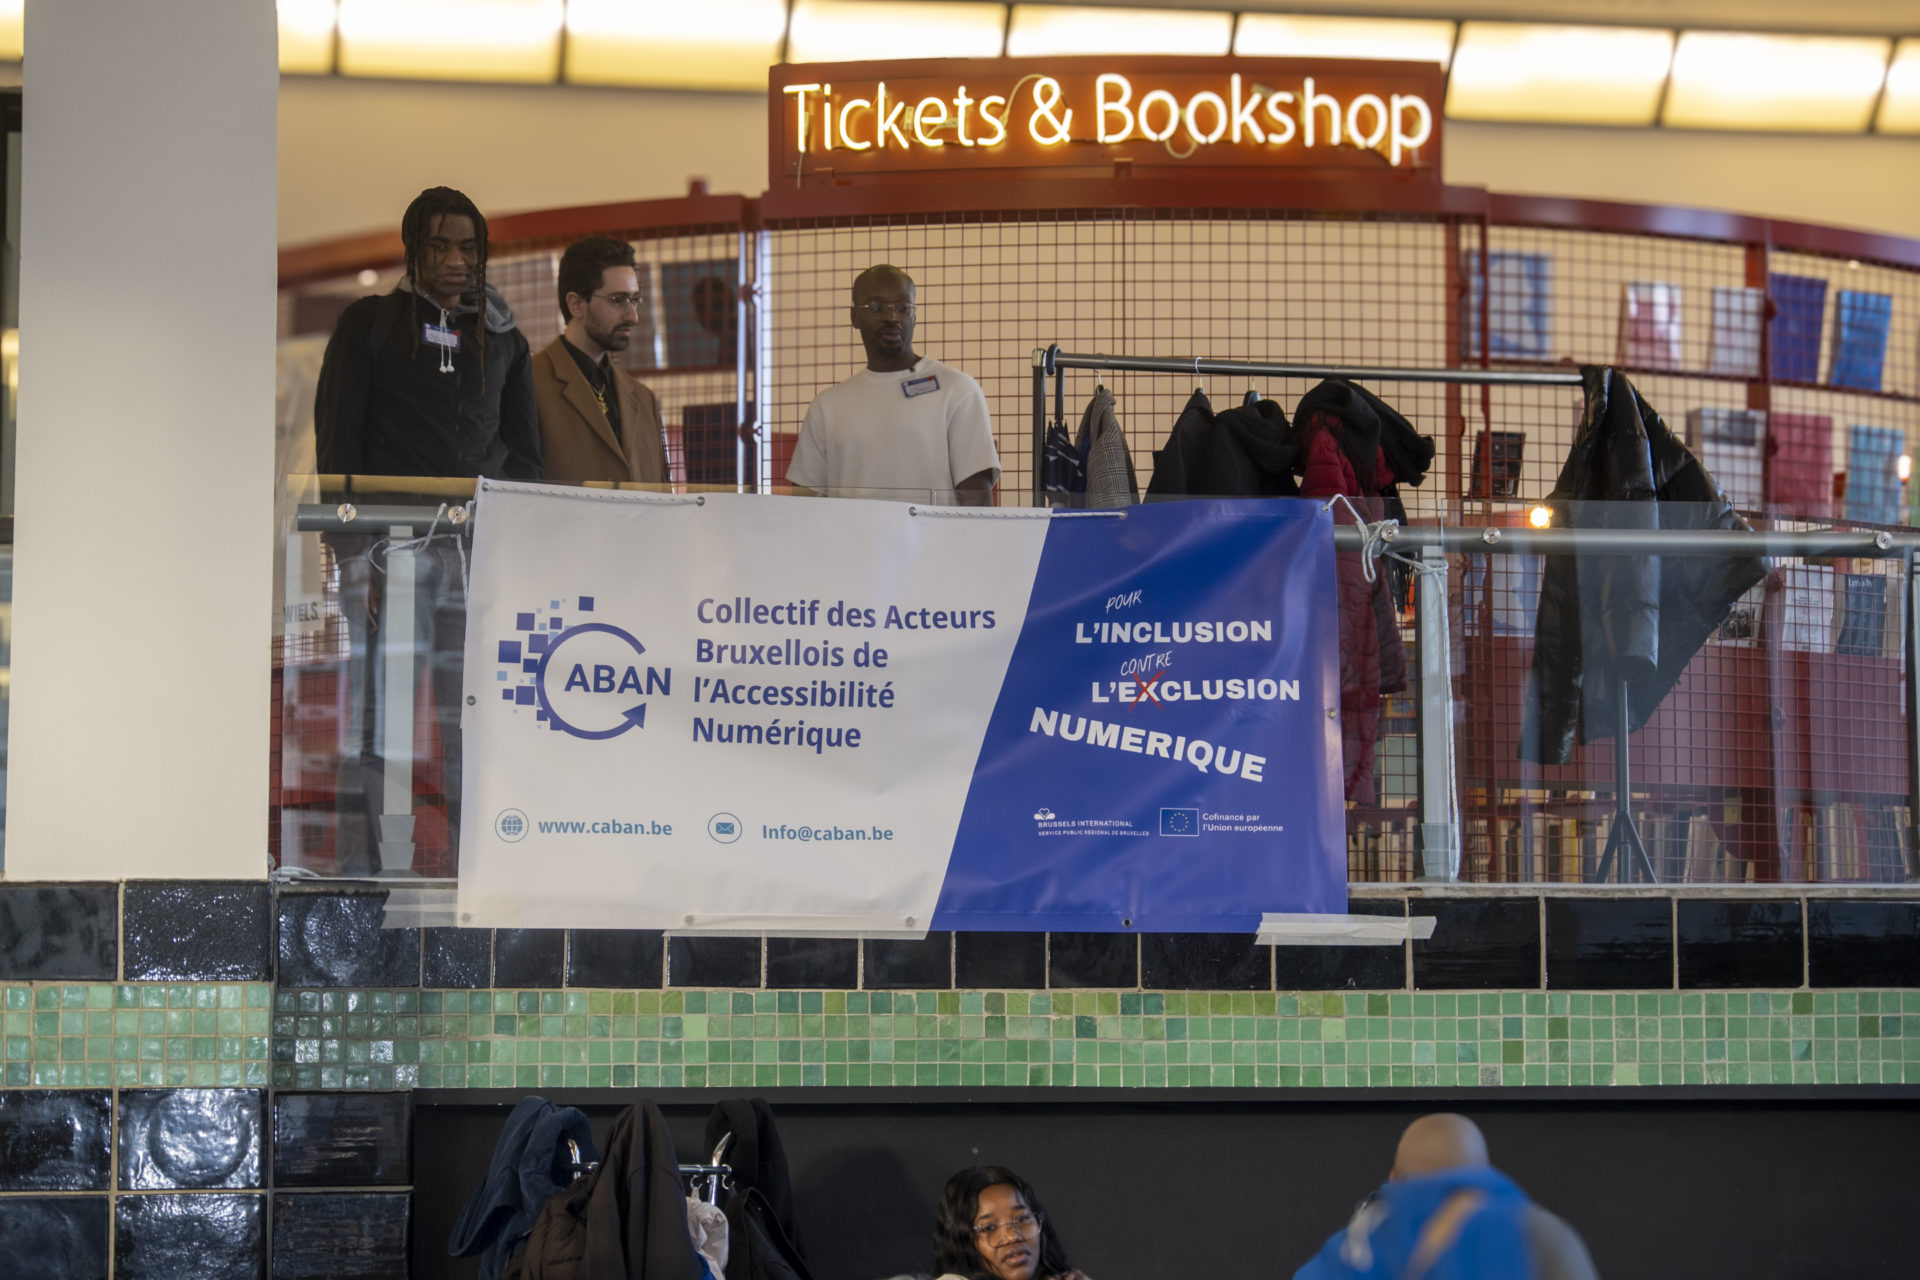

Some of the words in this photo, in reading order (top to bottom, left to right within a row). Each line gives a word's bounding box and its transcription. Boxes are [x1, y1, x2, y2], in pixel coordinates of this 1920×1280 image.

[783, 81, 1005, 153] Tickets
[1028, 75, 1073, 144] &
[1095, 72, 1432, 167] Bookshop
[697, 597, 821, 626] Collectif
[827, 600, 876, 628] des
[883, 605, 996, 630] Acteurs
[1105, 589, 1143, 614] POUR
[1075, 620, 1272, 644] L'INCLUSION
[696, 638, 844, 667] Bruxellois
[853, 641, 888, 668] de
[1120, 650, 1173, 677] CONTRE
[694, 676, 895, 708] l'Accessibilité
[1091, 679, 1300, 703] L'EXCLUSION
[692, 717, 861, 754] Numérique
[1029, 706, 1266, 783] NUMERIQUE
[538, 819, 672, 836] www.caban.be
[762, 824, 894, 843] Info@caban.be
[1038, 820, 1076, 828] BRUSSELS
[1077, 820, 1133, 828] INTERNATIONAL
[1202, 823, 1232, 831] l'Union
